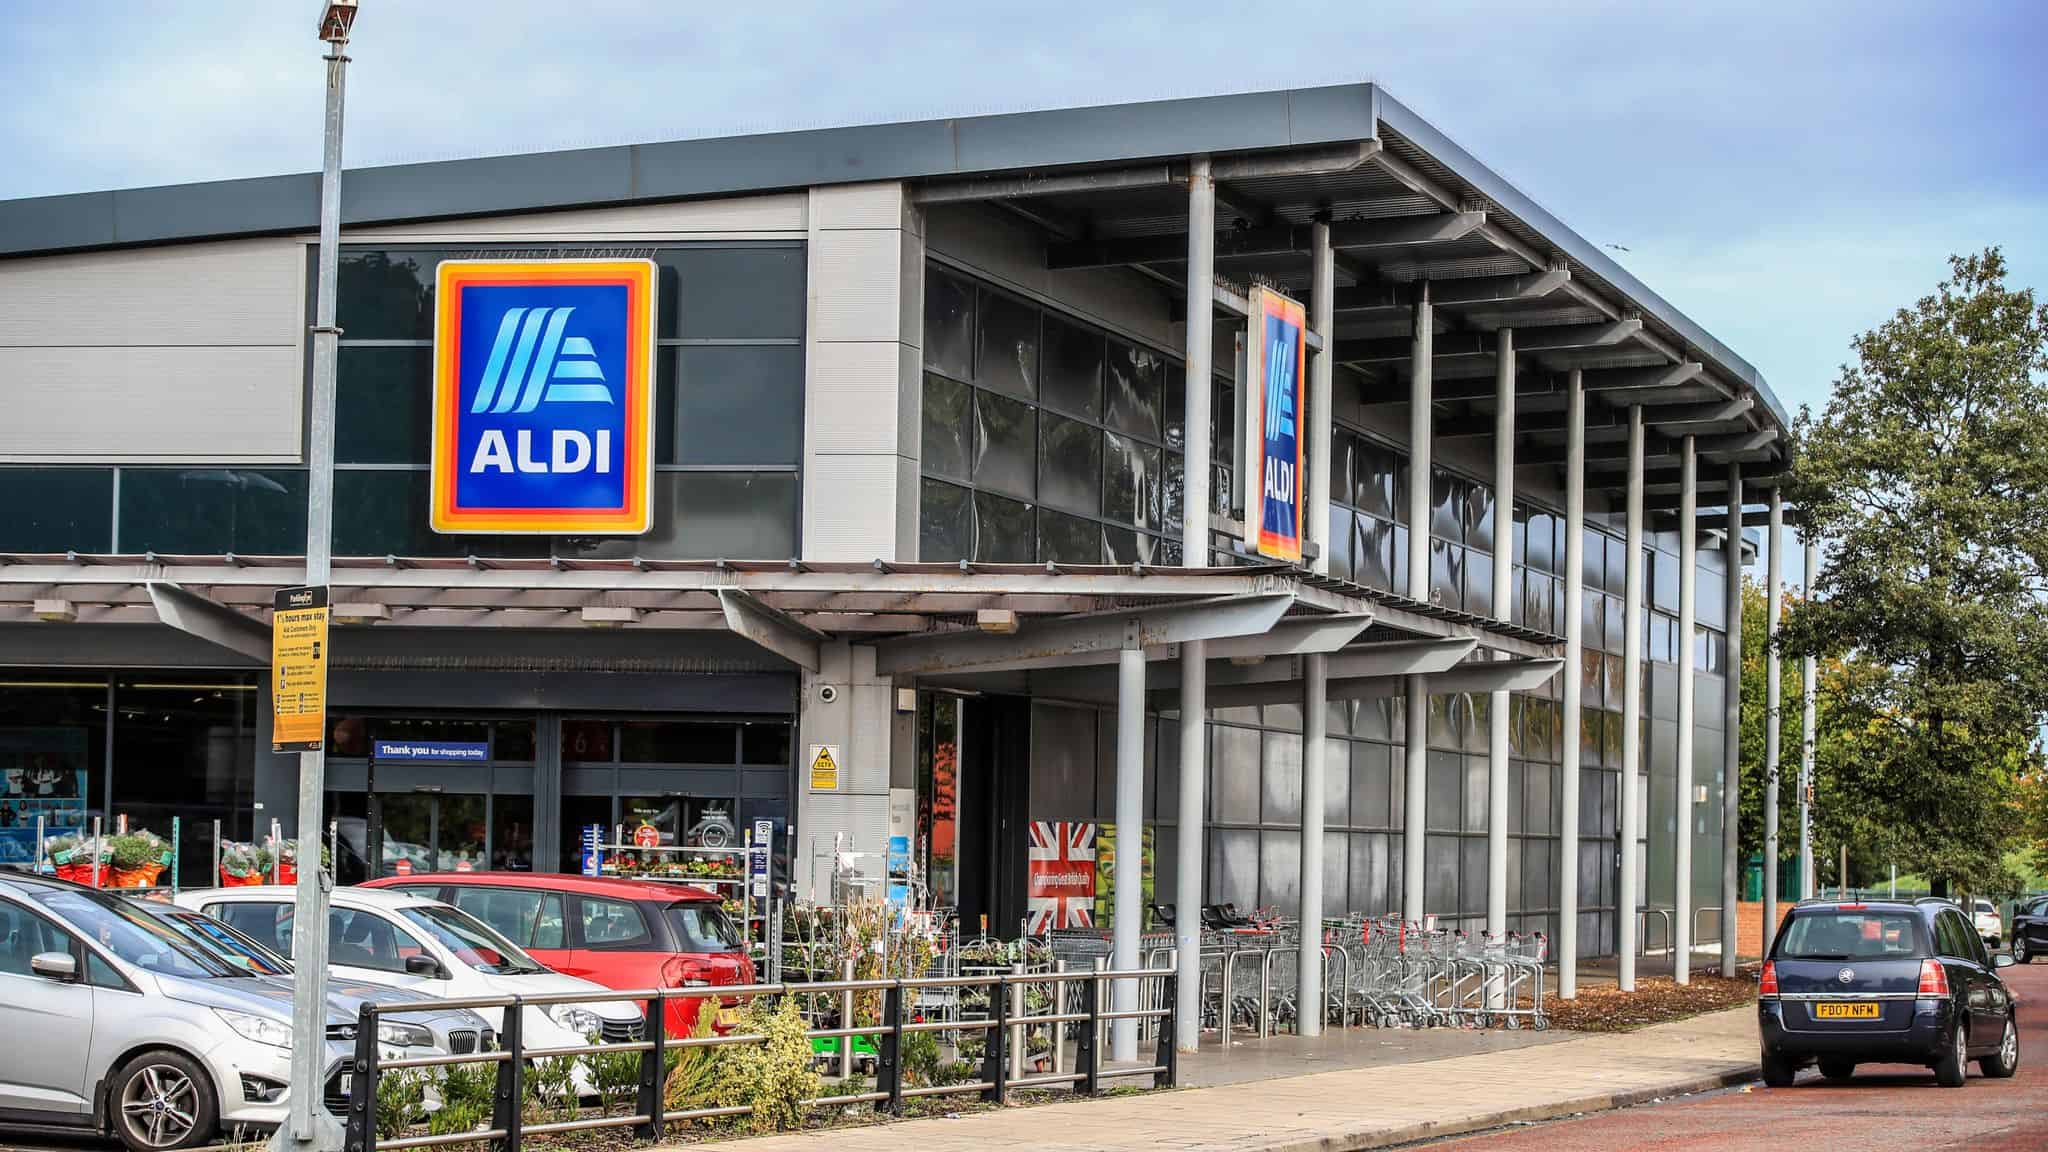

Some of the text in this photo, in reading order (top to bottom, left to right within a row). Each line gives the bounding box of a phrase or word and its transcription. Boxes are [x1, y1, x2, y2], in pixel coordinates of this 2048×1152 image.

[470, 429, 610, 473] ALDI
[1265, 455, 1294, 505] ALDI
[382, 745, 411, 755] Thank
[411, 747, 430, 758] you
[439, 748, 467, 757] shopping
[467, 749, 484, 758] today
[1821, 1005, 1874, 1016] FD07 NFM
